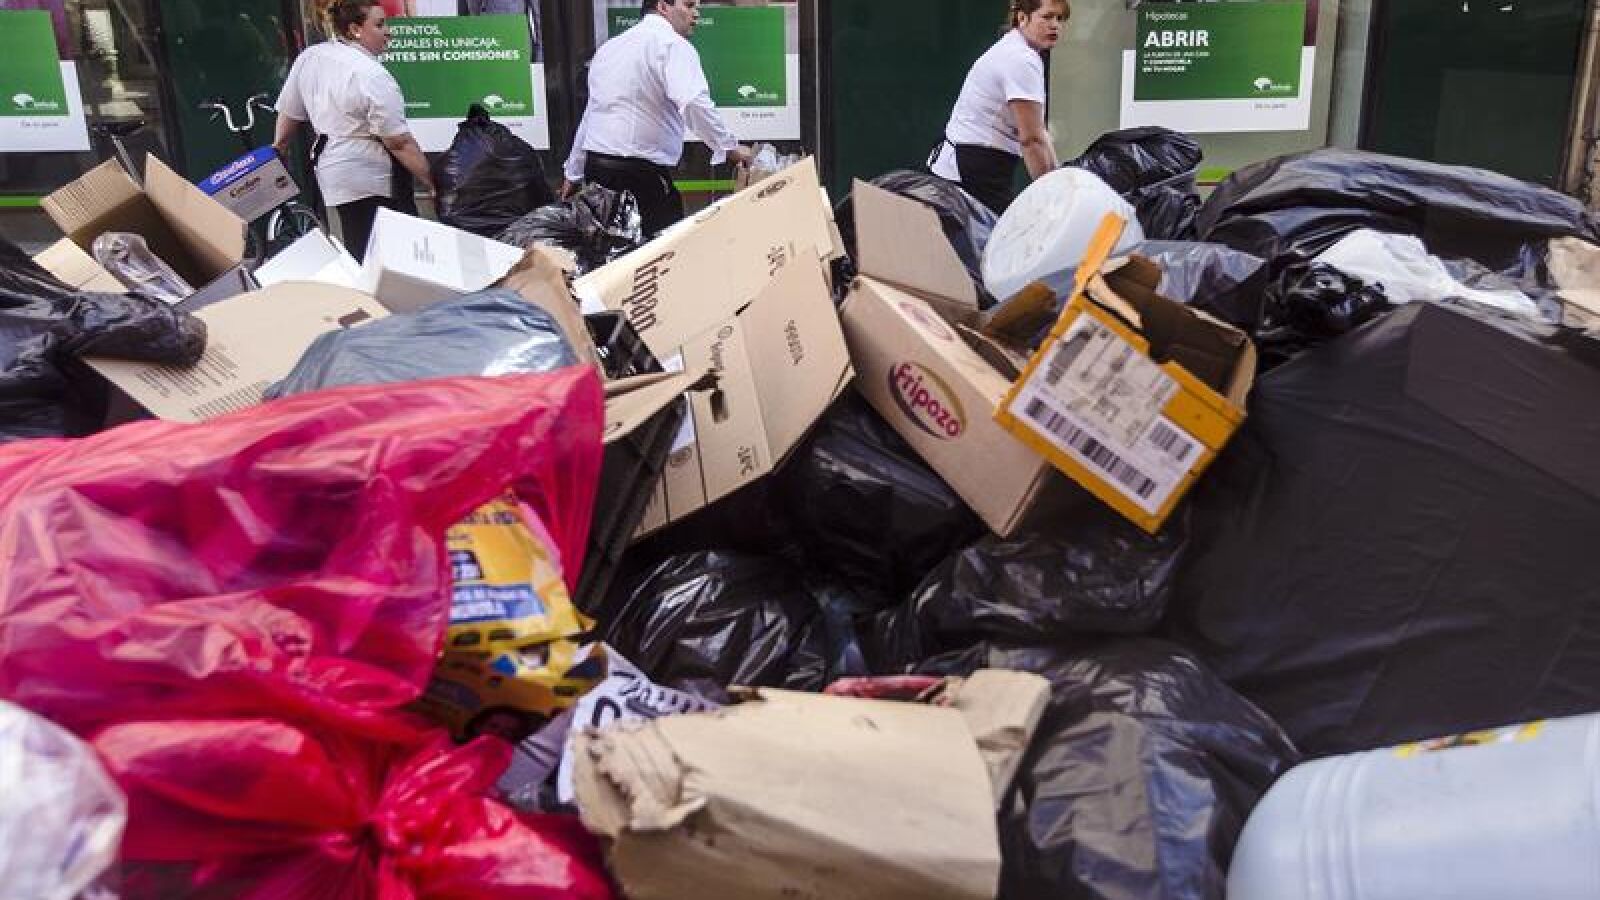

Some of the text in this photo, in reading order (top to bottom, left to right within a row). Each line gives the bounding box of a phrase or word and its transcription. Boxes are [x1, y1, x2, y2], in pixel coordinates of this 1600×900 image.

[1143, 29, 1209, 48] ABRIR
[443, 50, 520, 61] COMISIONES
[621, 251, 675, 333] fripan
